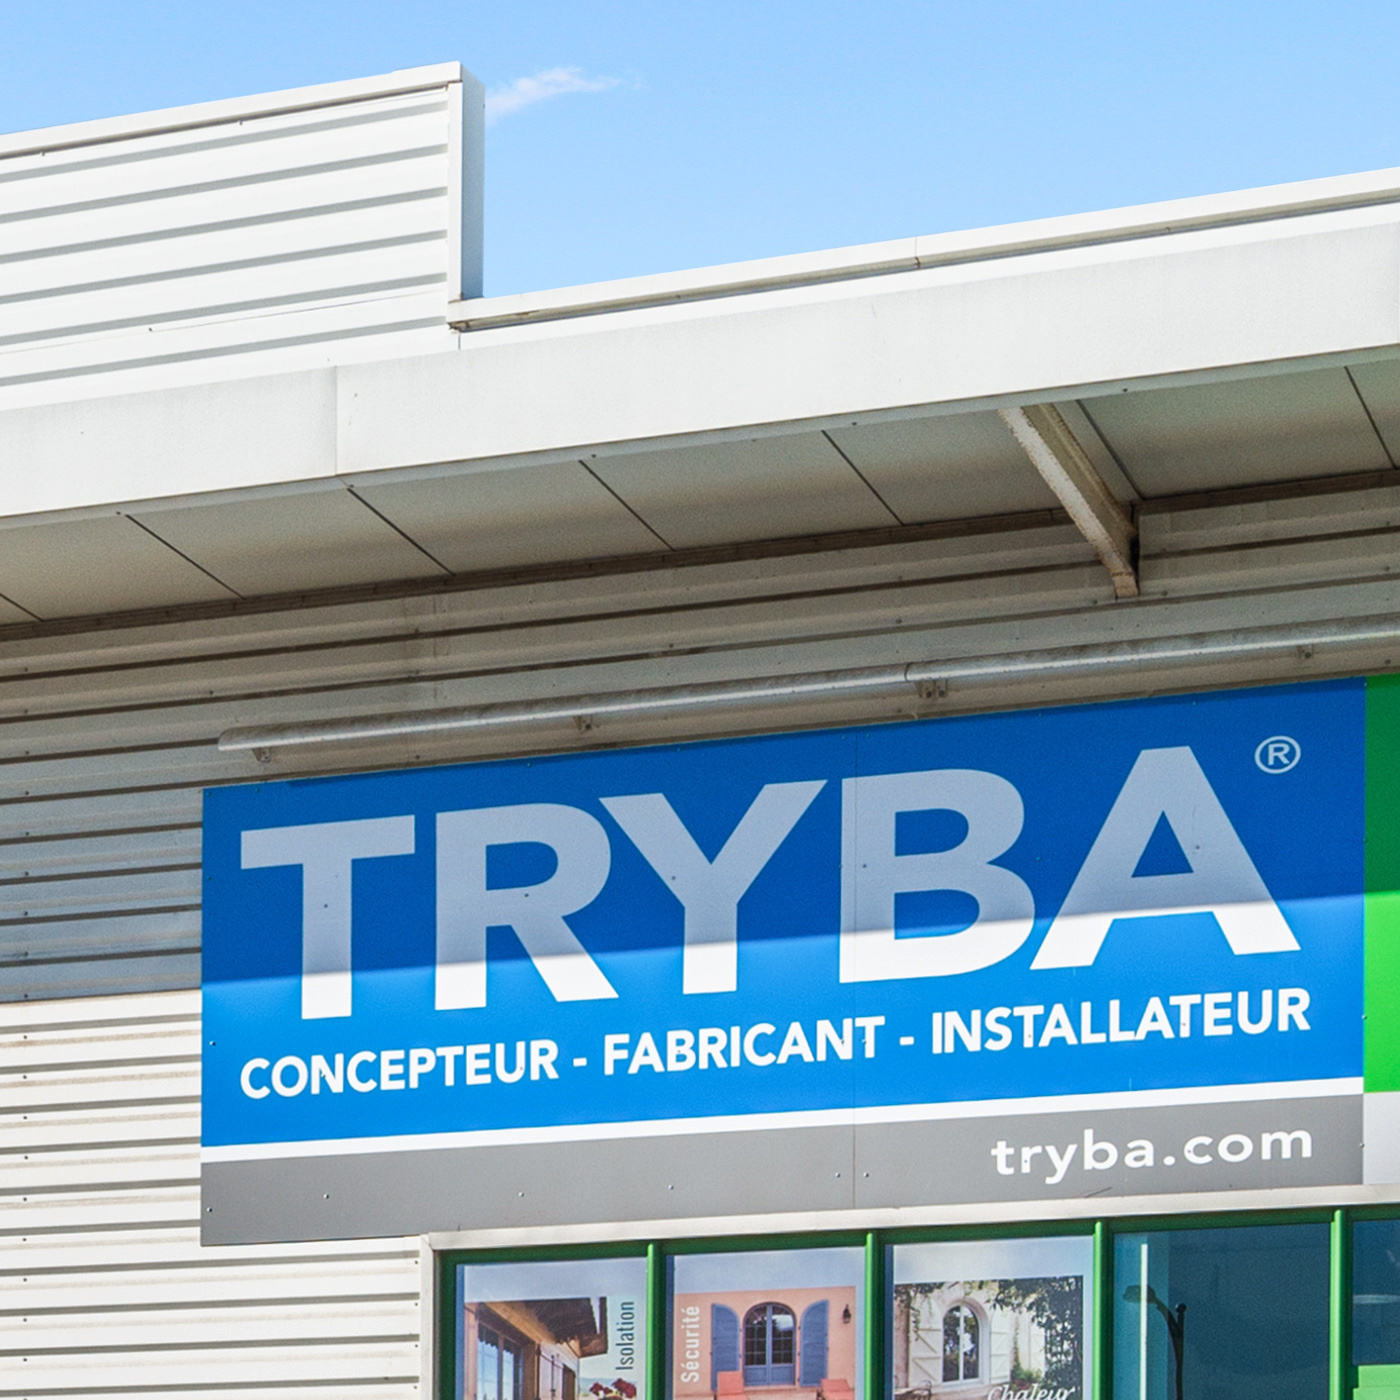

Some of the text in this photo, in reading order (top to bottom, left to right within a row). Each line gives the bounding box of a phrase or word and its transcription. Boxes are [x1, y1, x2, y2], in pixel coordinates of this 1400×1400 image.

[240, 745, 1302, 1021] TRYBA
[239, 1041, 560, 1101] CONCEPTEUR
[603, 1017, 886, 1077] FABRICANT
[931, 988, 1311, 1055] INSTALLATEUR
[989, 1128, 1315, 1186] tryba.com
[615, 1301, 635, 1370] Isolation
[680, 1305, 700, 1383] Sécurité
